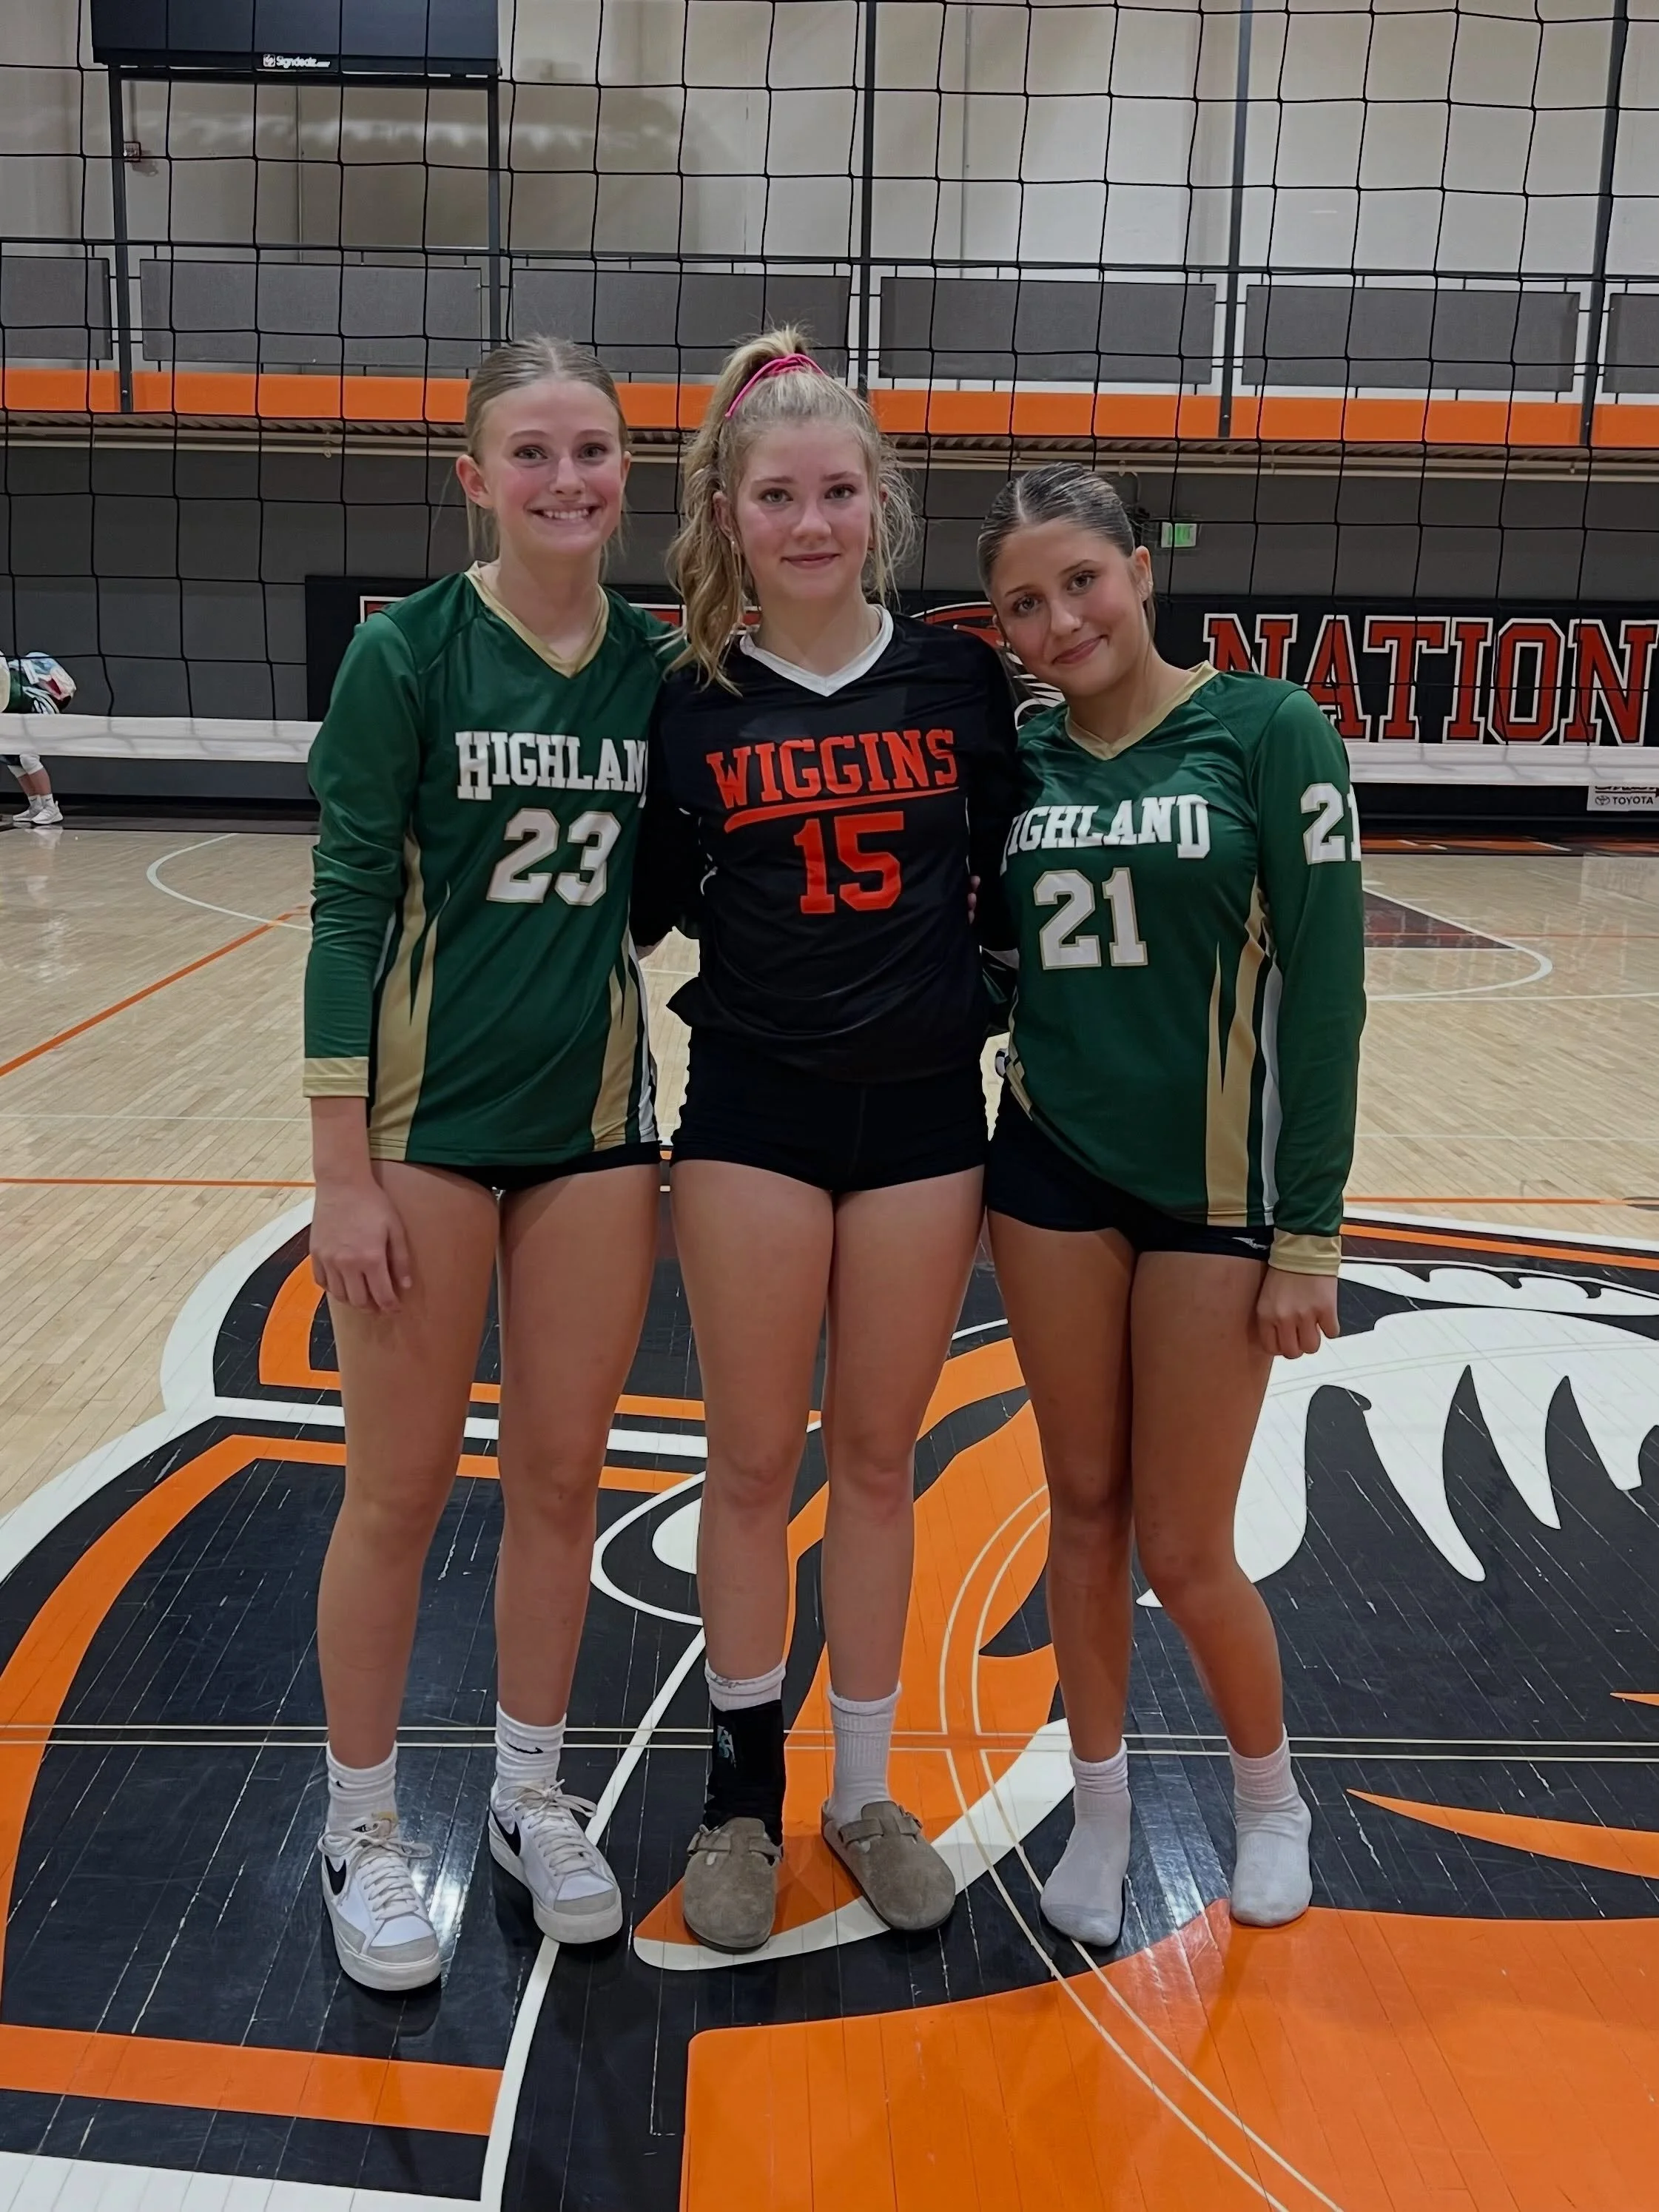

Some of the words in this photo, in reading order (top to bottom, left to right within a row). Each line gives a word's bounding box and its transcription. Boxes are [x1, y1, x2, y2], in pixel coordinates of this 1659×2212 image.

[455, 730, 648, 808] HIGHLAN
[706, 729, 958, 809] WIGGINS
[1612, 796, 1654, 806] TOYOTA
[486, 808, 621, 906] 23
[794, 811, 904, 914] 15
[1033, 867, 1148, 970] 21
